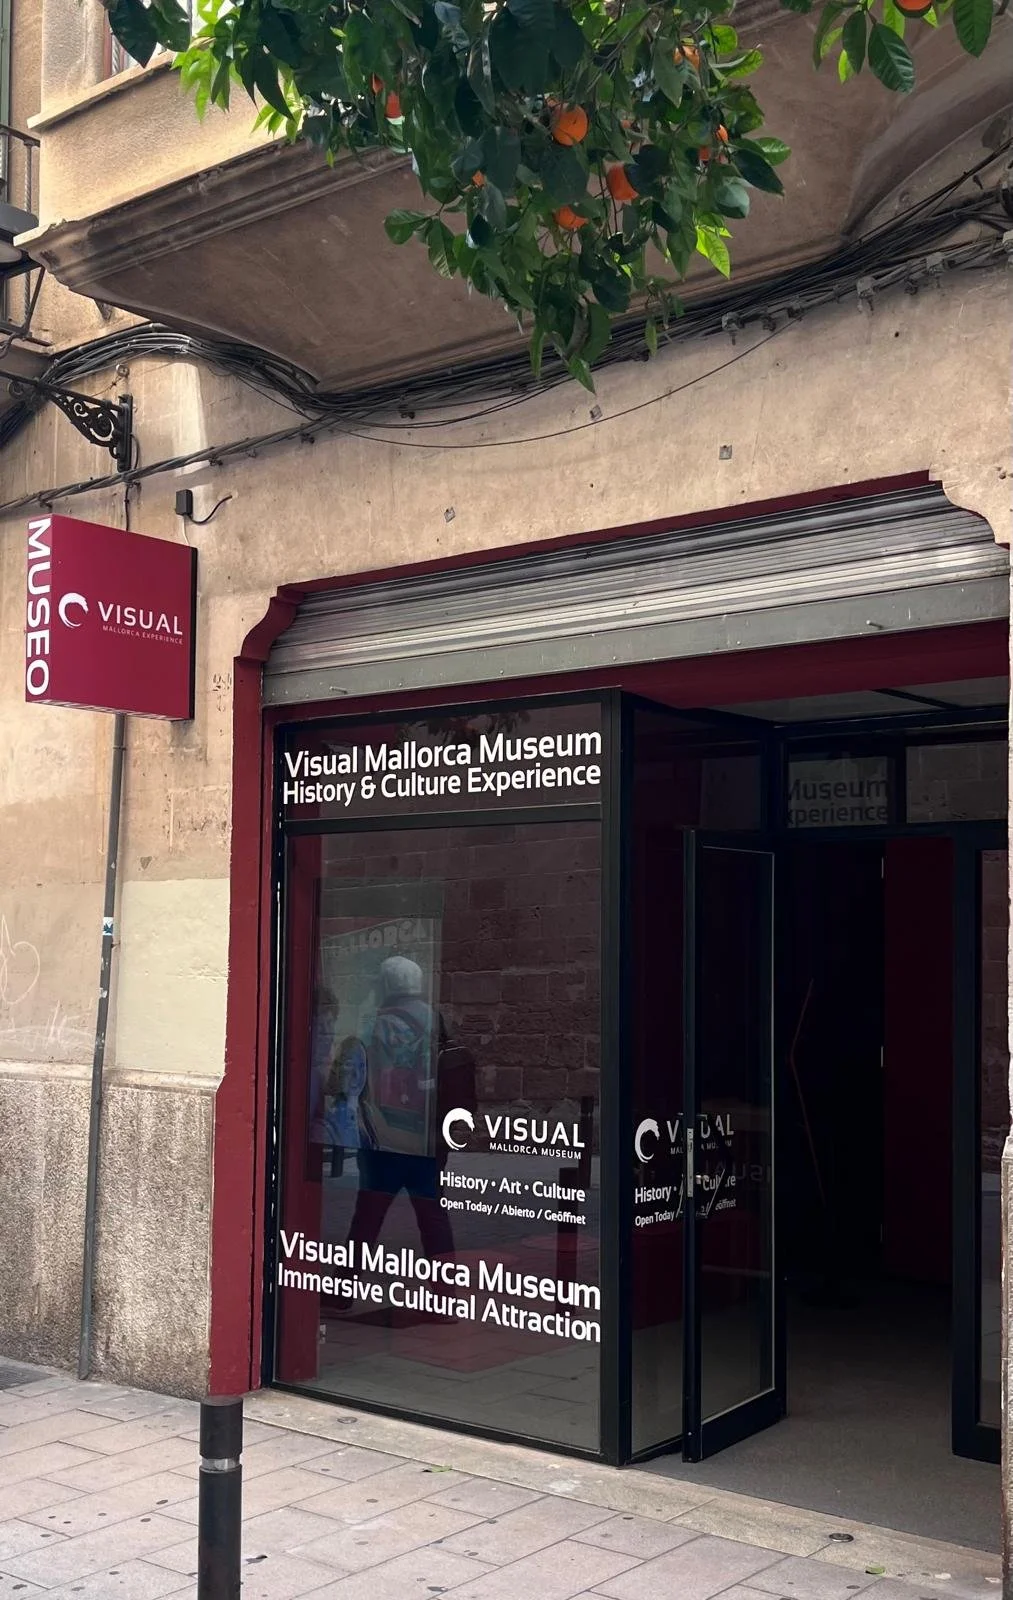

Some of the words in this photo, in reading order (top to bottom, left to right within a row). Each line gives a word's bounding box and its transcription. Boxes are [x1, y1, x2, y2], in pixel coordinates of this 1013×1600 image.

[26, 517, 51, 696] MUSEO
[97, 600, 184, 636] VISUAL
[102, 625, 141, 637] MALLORCA
[142, 632, 184, 645] EXPERIENCE
[284, 743, 358, 778] Visual
[365, 740, 471, 773] Mallorca
[479, 731, 602, 764] Museum
[283, 780, 357, 807] History
[360, 772, 378, 800] &
[380, 766, 461, 798] Culture
[467, 762, 602, 797] Experience
[484, 1113, 586, 1149] VISUAL
[489, 1143, 538, 1155] MALLORCA
[541, 1148, 582, 1160] MUSEUM
[440, 1170, 489, 1194] History
[499, 1177, 522, 1194] Art
[532, 1180, 586, 1202] Culture
[634, 1185, 673, 1205] History
[440, 1197, 464, 1211] Open
[465, 1200, 493, 1215] Today
[501, 1204, 535, 1219] Abierto
[544, 1209, 586, 1225] Geöffnet
[634, 1214, 654, 1228] Open
[654, 1210, 675, 1223] Today
[280, 1229, 355, 1268] Visual
[361, 1241, 470, 1288] Mallorca
[478, 1259, 601, 1311] Museum
[278, 1262, 384, 1303] Immersive
[388, 1281, 476, 1321] Cultural
[482, 1297, 601, 1343] Attraction
